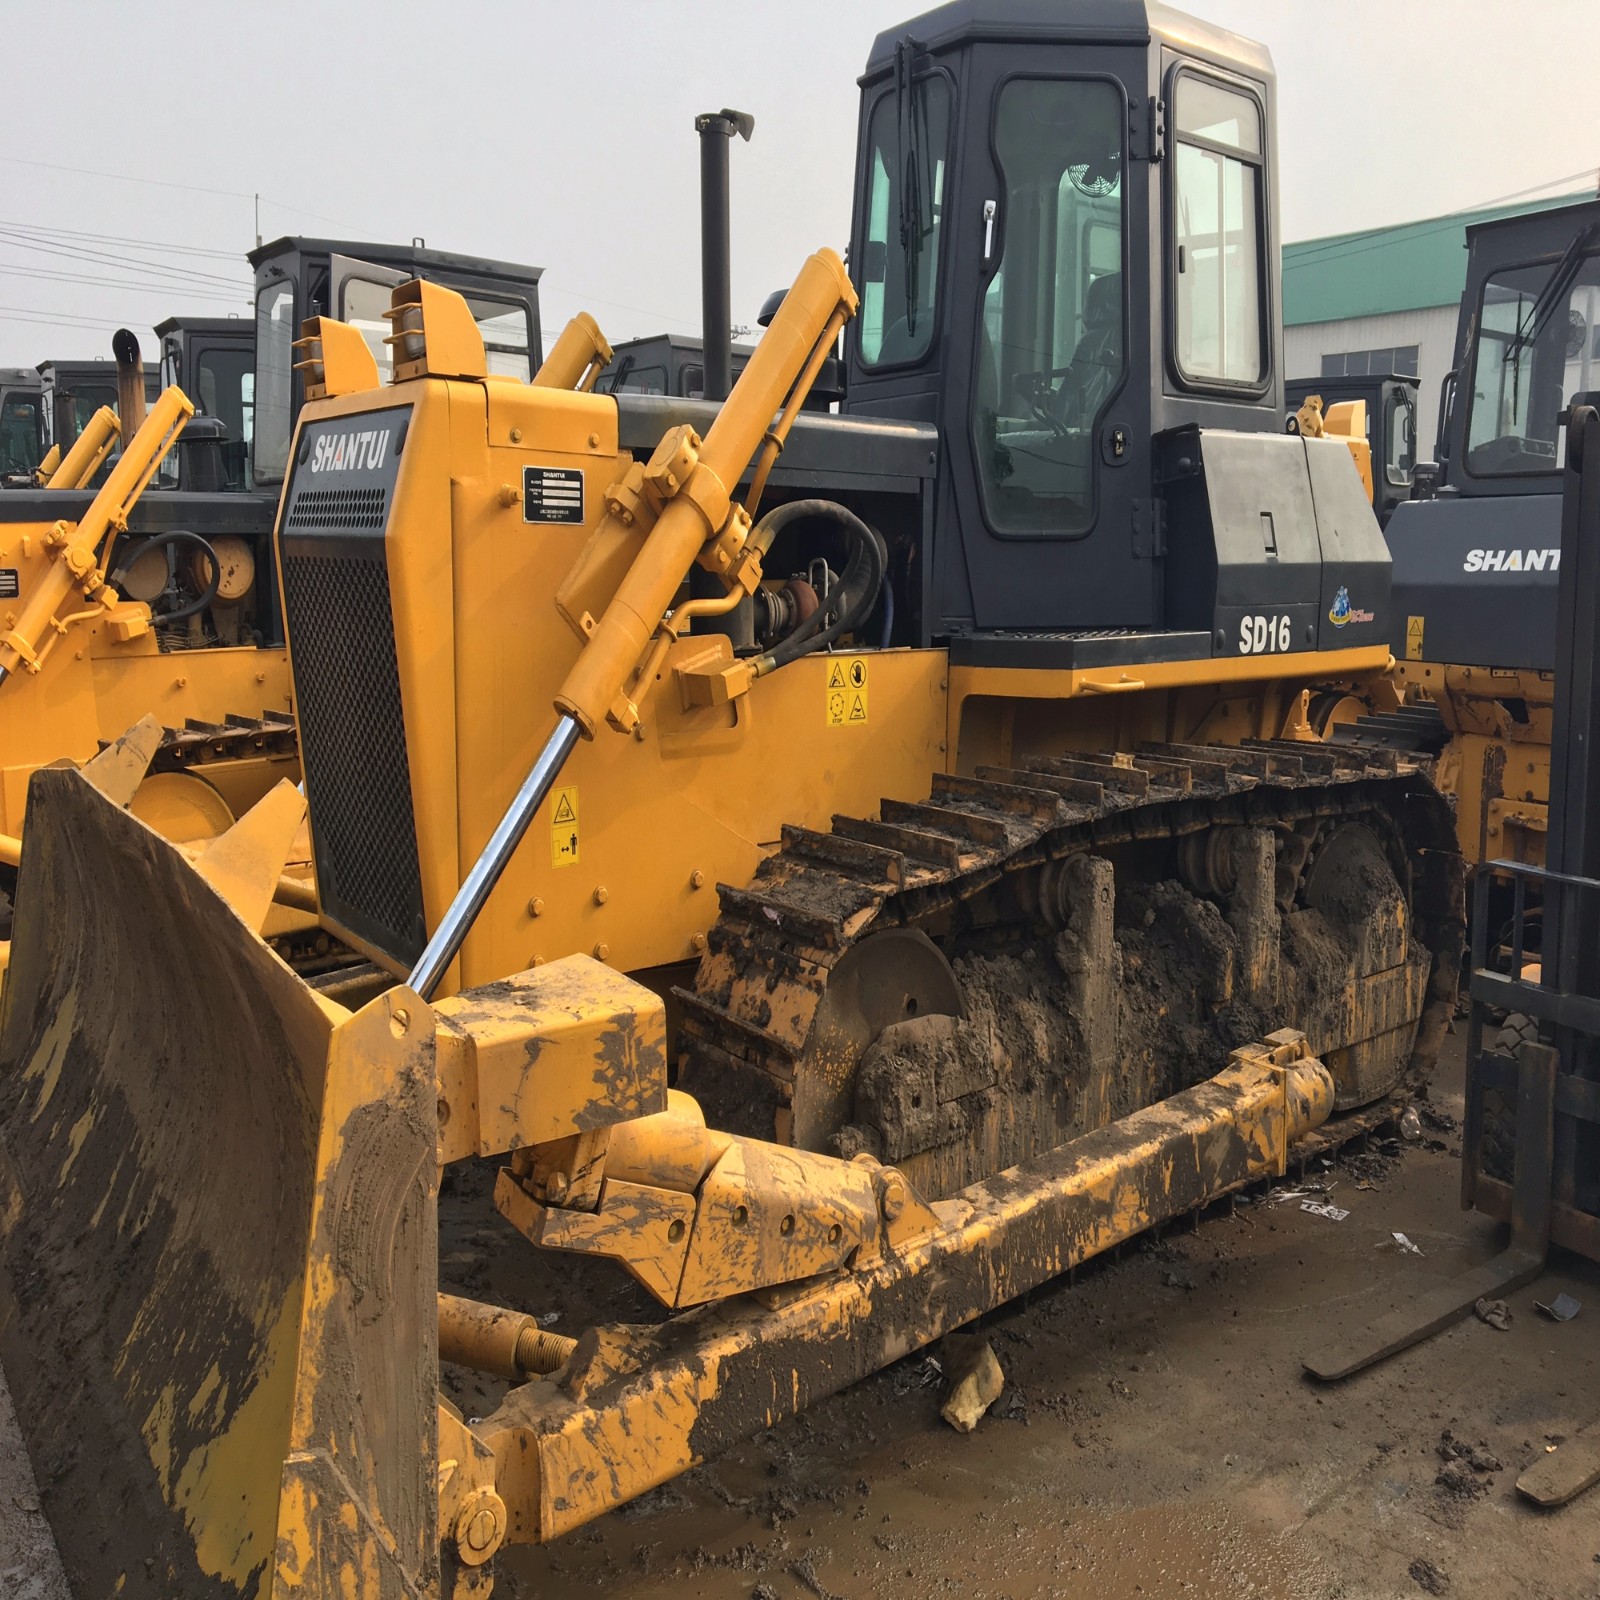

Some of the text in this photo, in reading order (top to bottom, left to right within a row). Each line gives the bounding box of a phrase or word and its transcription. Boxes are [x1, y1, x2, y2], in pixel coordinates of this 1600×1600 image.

[311, 429, 391, 473] SHANTUI
[1463, 549, 1561, 572] SHANT
[1239, 615, 1291, 654] SD16
